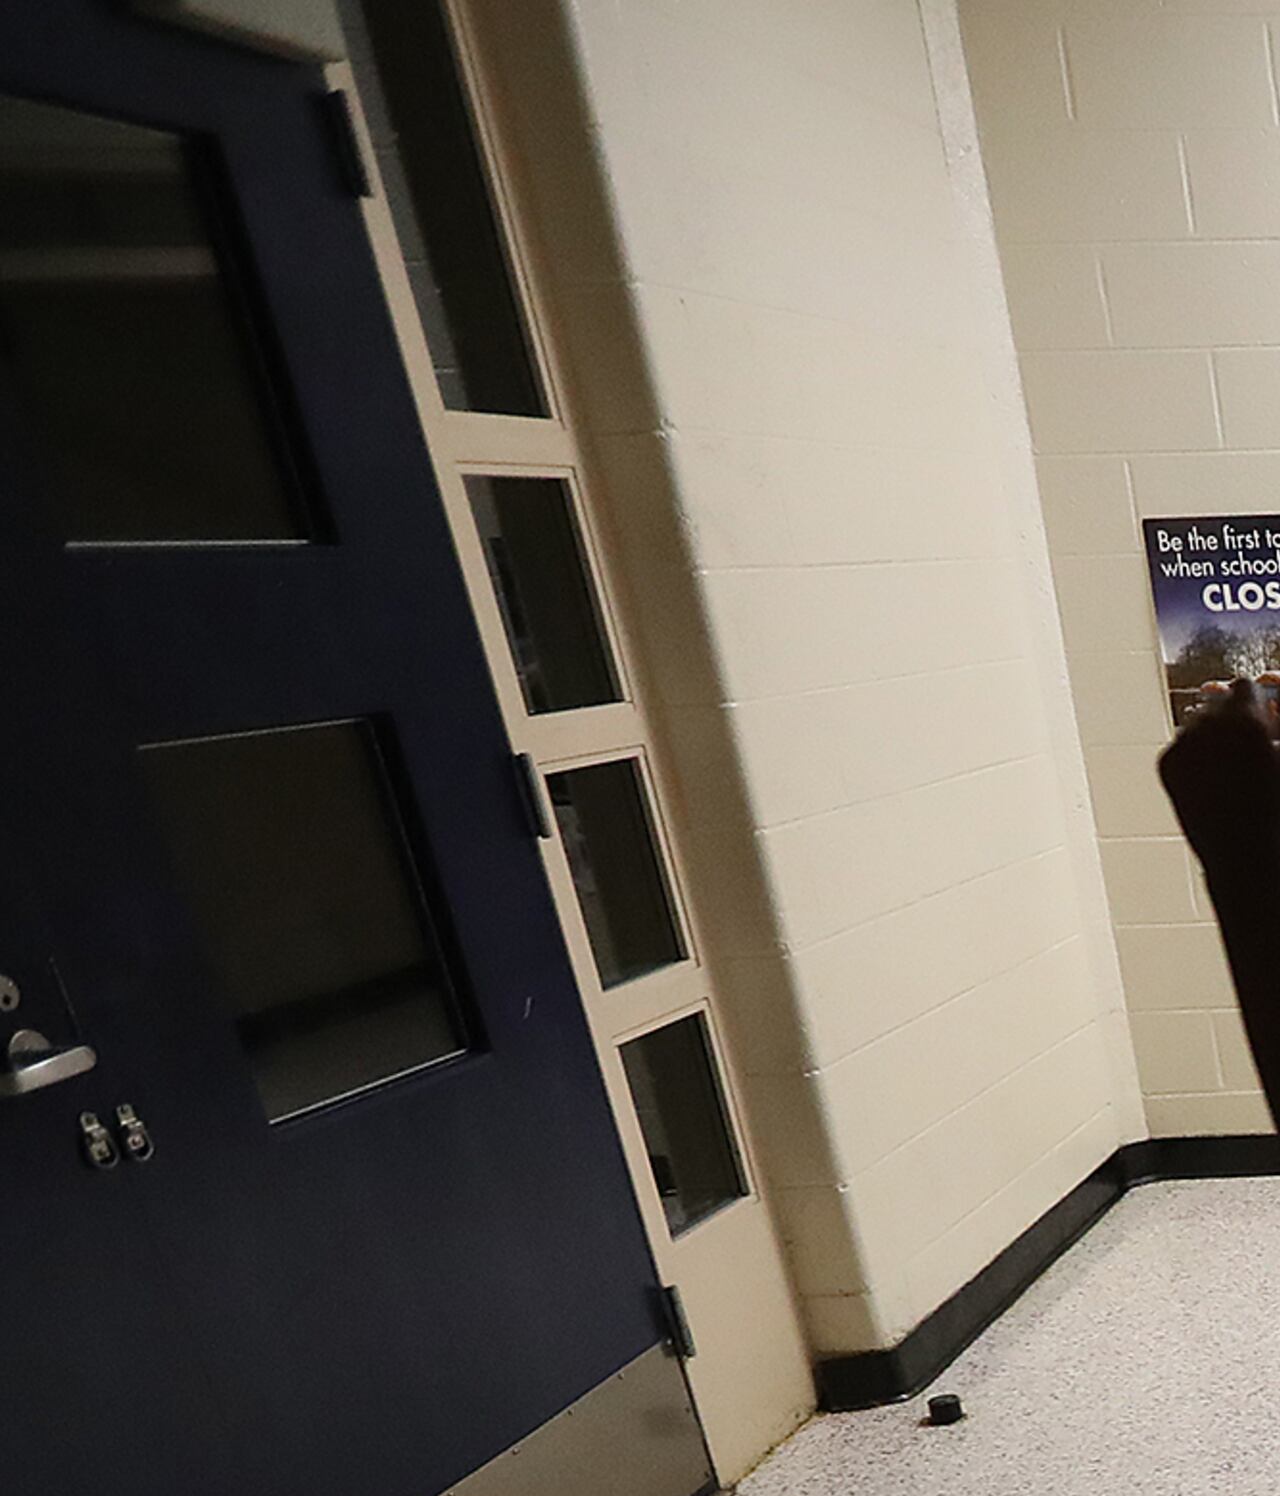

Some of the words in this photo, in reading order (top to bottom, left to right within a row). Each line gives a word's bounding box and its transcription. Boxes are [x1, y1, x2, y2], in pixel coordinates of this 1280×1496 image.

[1157, 531, 1183, 552] Be
[1188, 526, 1218, 550] the
[1223, 524, 1261, 550] first
[1161, 556, 1214, 578] when
